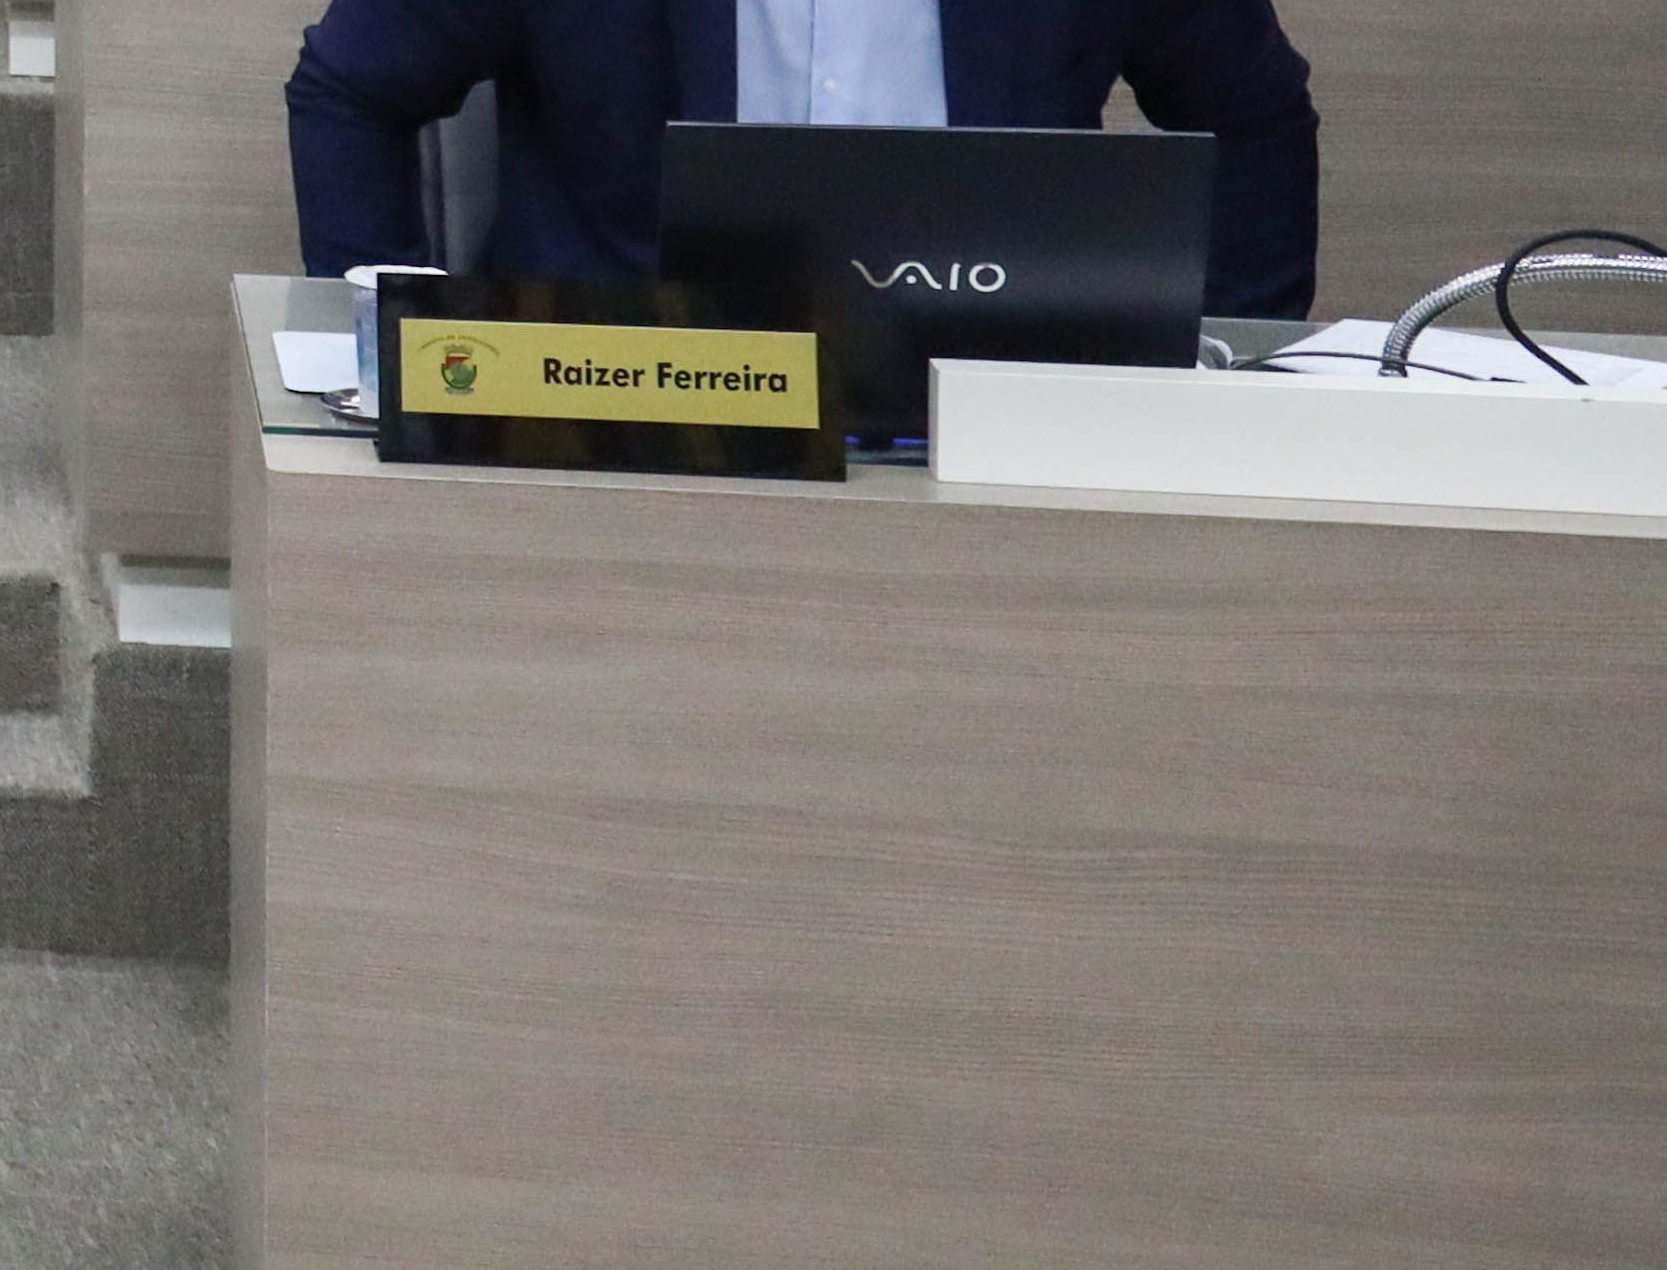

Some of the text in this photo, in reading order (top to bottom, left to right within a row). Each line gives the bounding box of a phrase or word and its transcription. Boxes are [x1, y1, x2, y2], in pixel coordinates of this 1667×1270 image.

[851, 258, 1007, 295] VAIO
[543, 357, 789, 395] Raizer Ferreira
